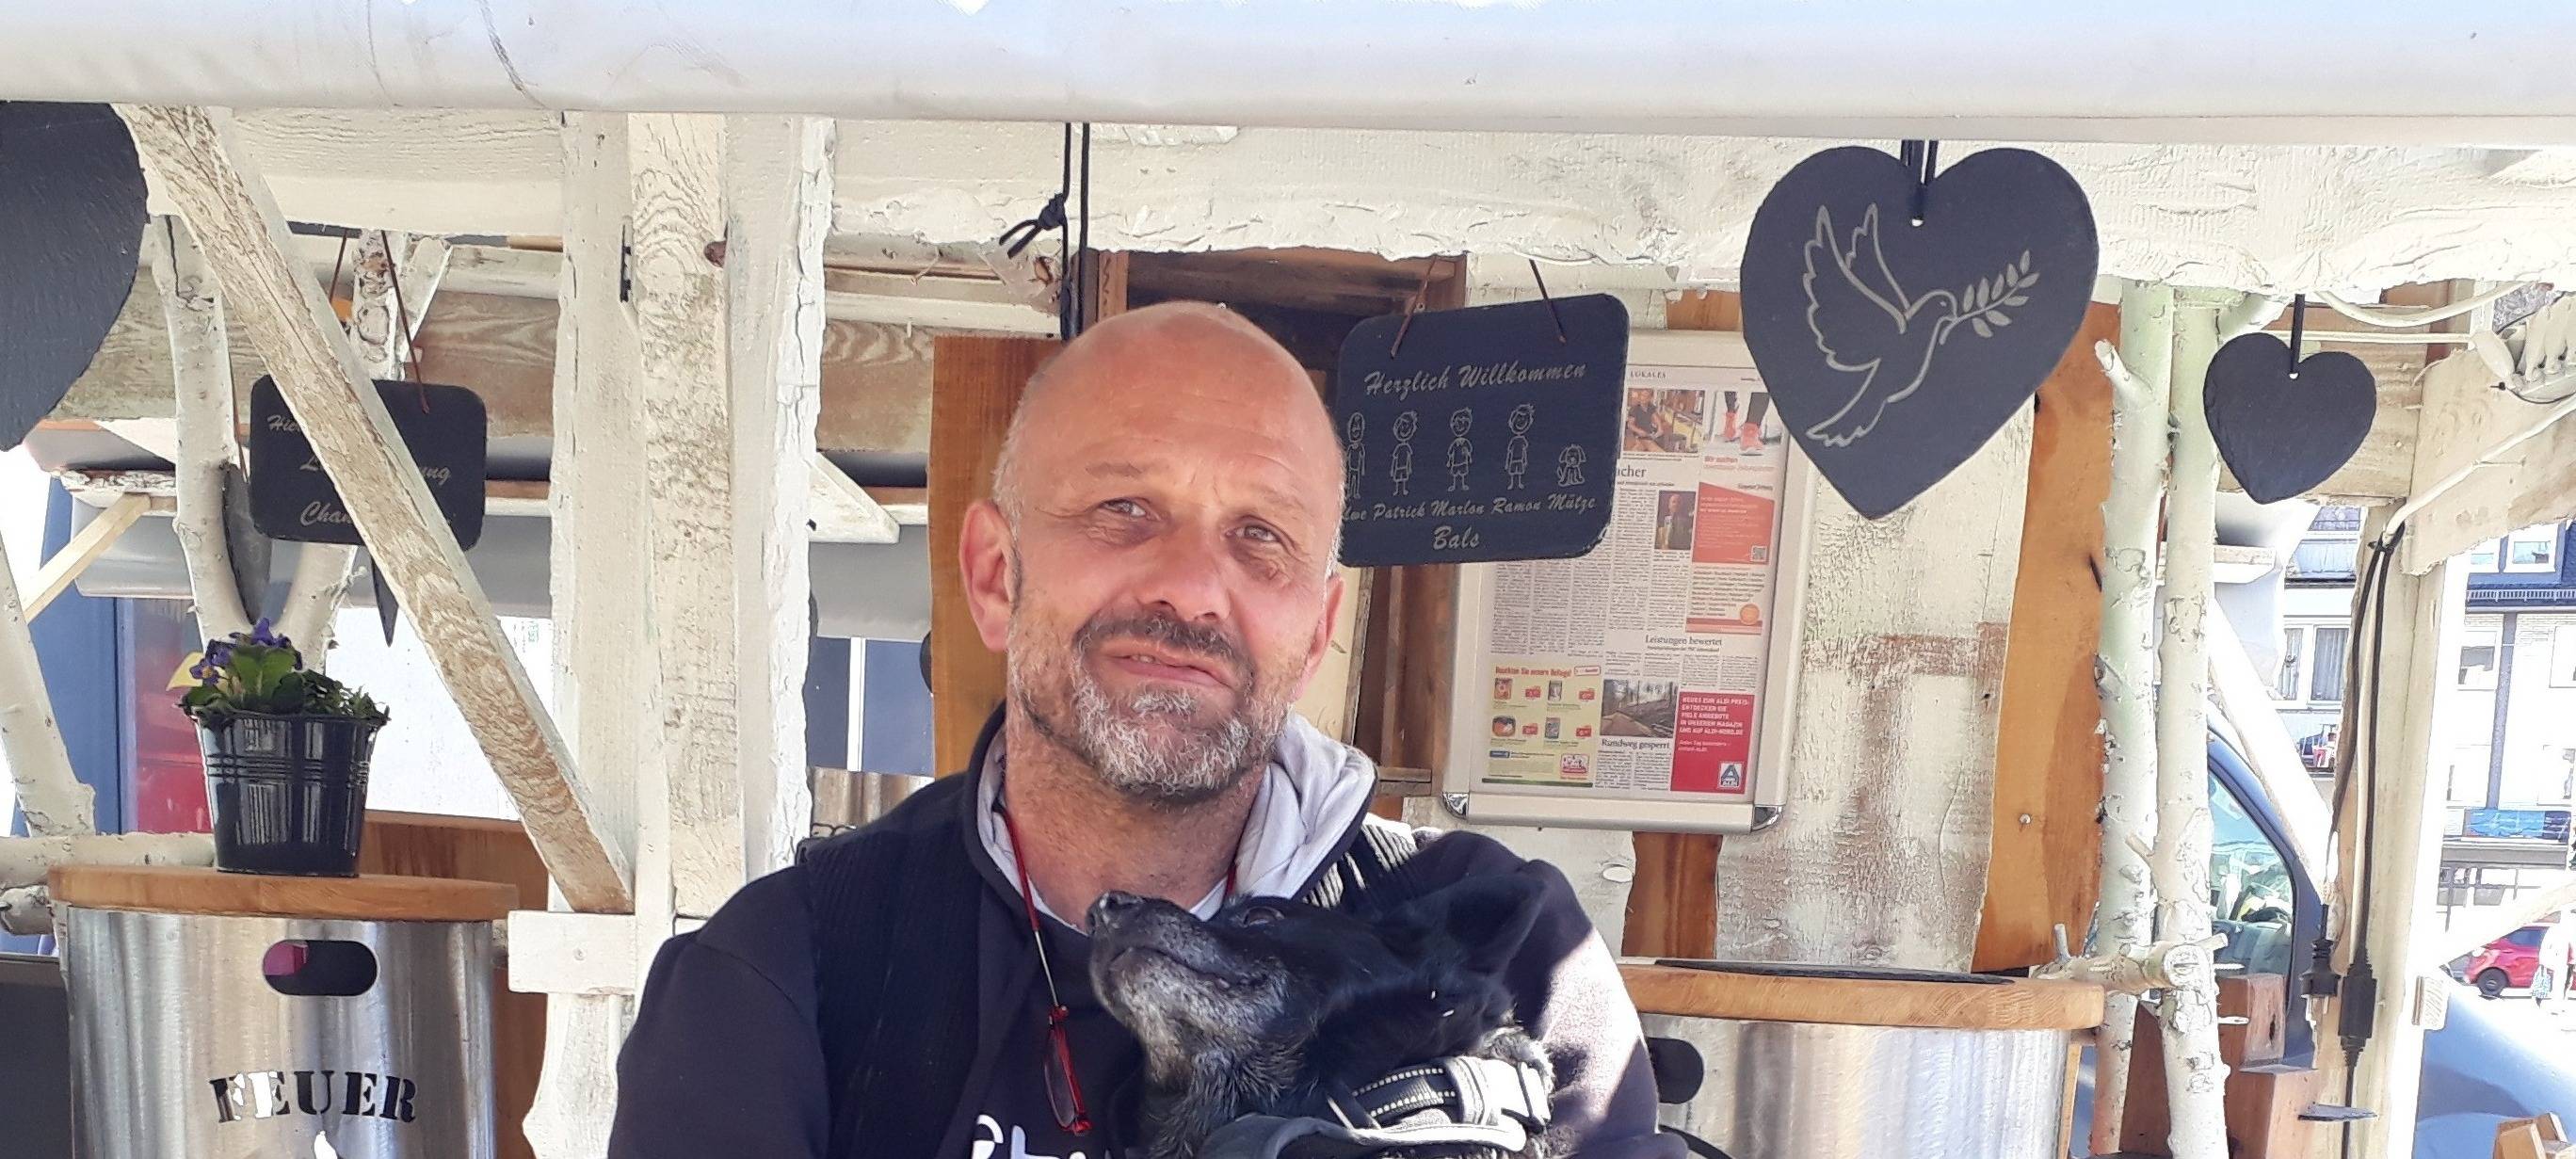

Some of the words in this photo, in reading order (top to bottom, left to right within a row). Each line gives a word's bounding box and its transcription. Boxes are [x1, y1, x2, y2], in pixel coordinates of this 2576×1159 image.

[1364, 365, 1451, 400] Herzlich
[1459, 361, 1587, 388] Willkommen
[1373, 502, 1425, 520] Patrick
[1431, 500, 1485, 516] Marlon
[1490, 497, 1541, 514] Ramon
[1547, 493, 1596, 514] Mütze
[1432, 525, 1480, 550] Bals
[209, 1070, 416, 1123] FEUER
